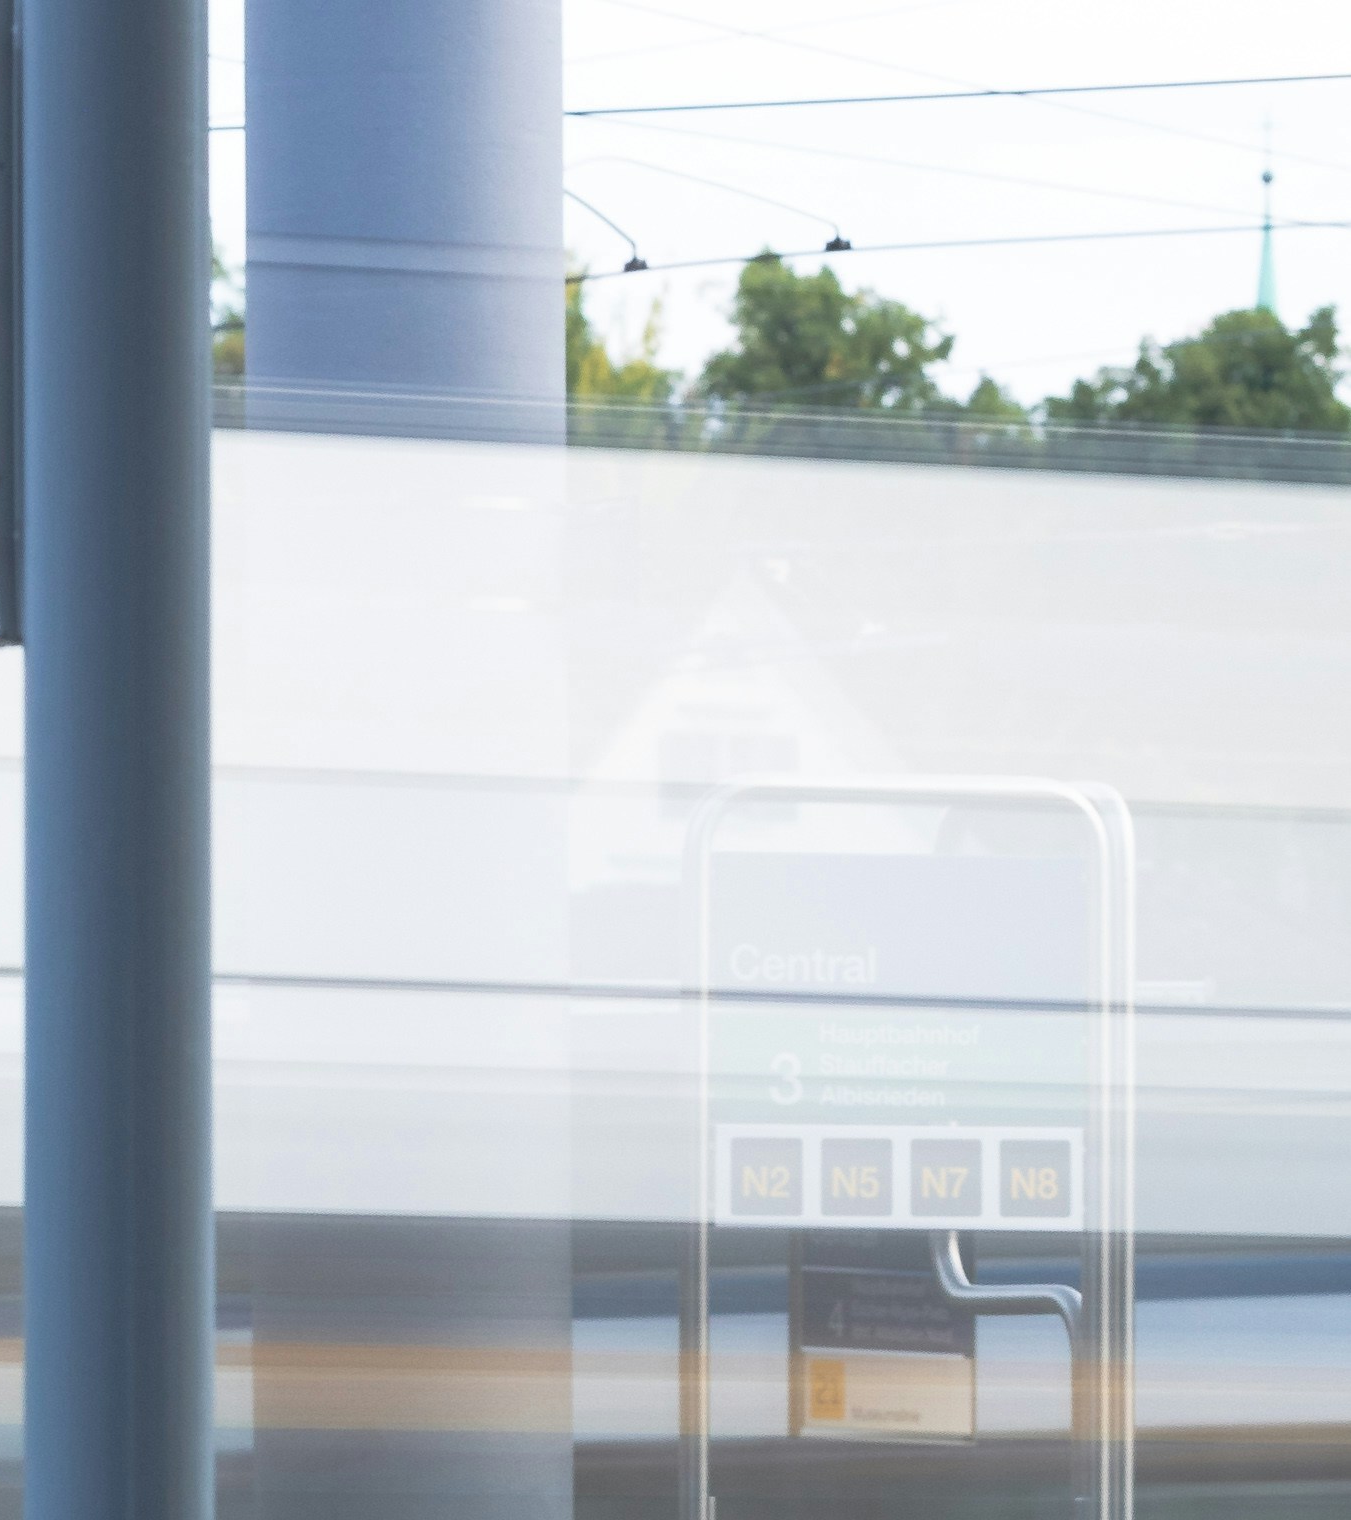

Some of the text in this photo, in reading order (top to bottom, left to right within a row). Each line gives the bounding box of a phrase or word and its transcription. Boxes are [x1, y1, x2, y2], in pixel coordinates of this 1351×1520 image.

[730, 944, 877, 983] Central
[819, 1023, 981, 1048] Hauptbahnhof
[769, 1053, 803, 1106] 3
[819, 1053, 949, 1077] Stauffacher
[741, 1166, 791, 1199] N2
[832, 1167, 880, 1199] N5
[921, 1168, 969, 1200] N7
[1010, 1169, 1059, 1201] N8
